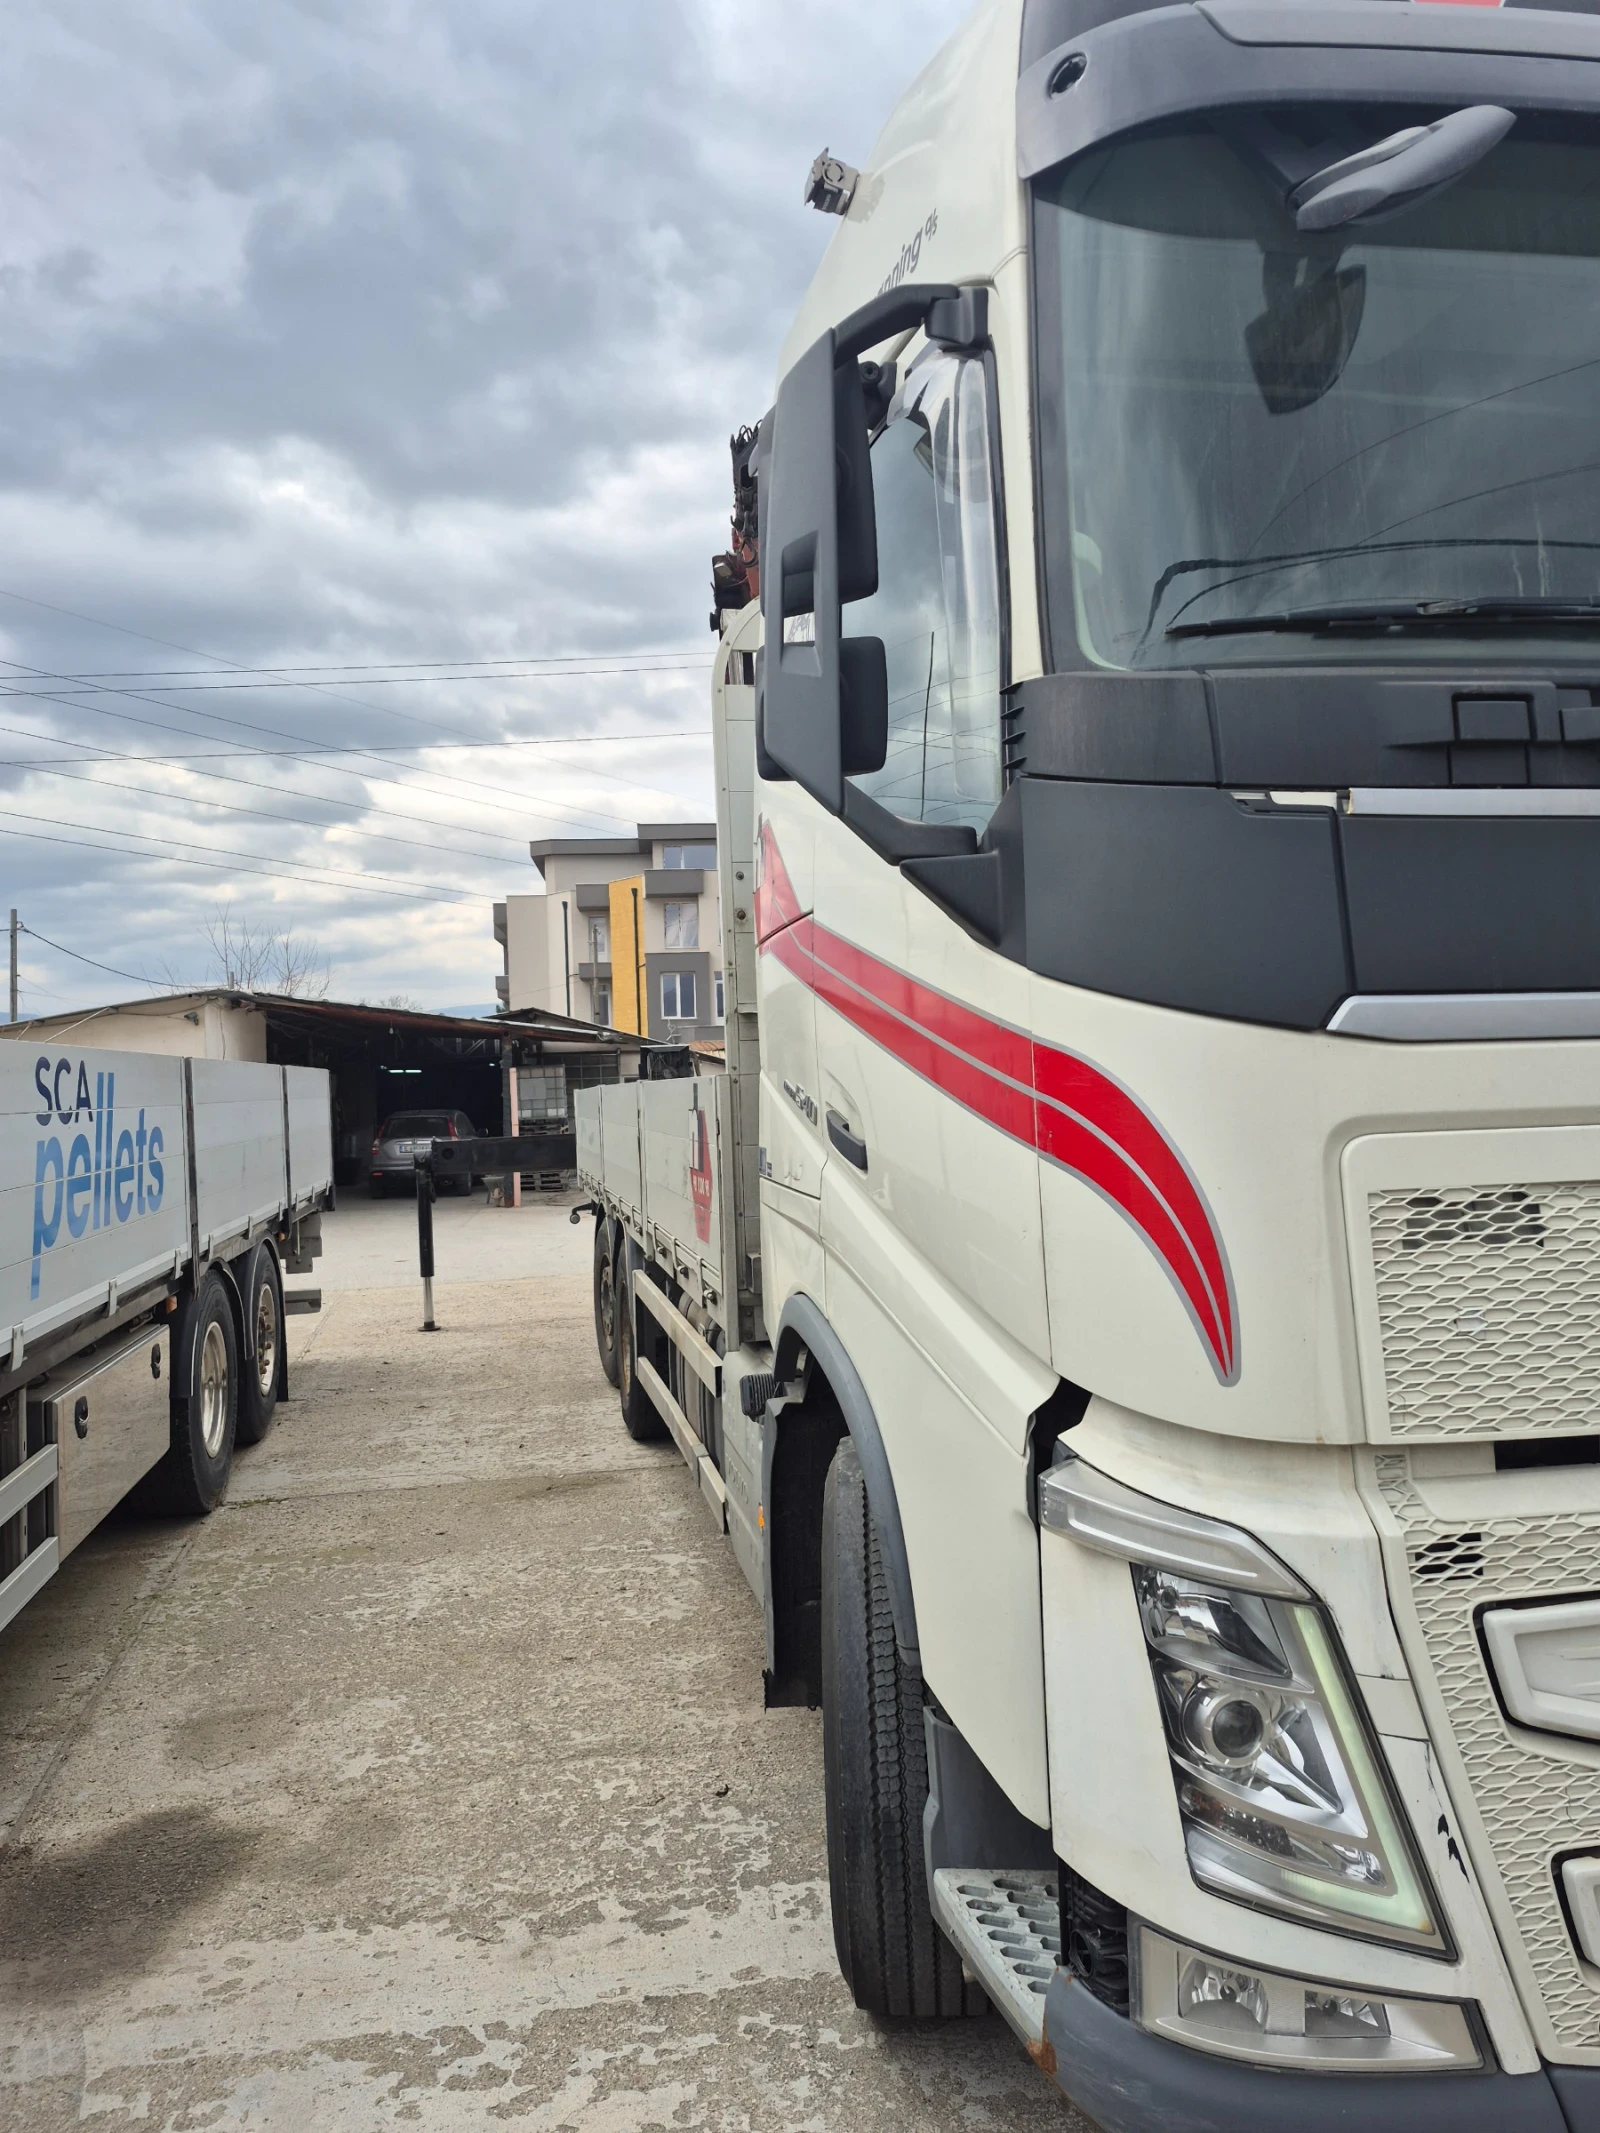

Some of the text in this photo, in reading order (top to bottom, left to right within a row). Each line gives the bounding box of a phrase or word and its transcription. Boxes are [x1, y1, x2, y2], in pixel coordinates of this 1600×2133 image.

[35, 1056, 93, 1127] SCA
[795, 1084, 818, 1126] 540
[30, 1072, 164, 1300] pellets
